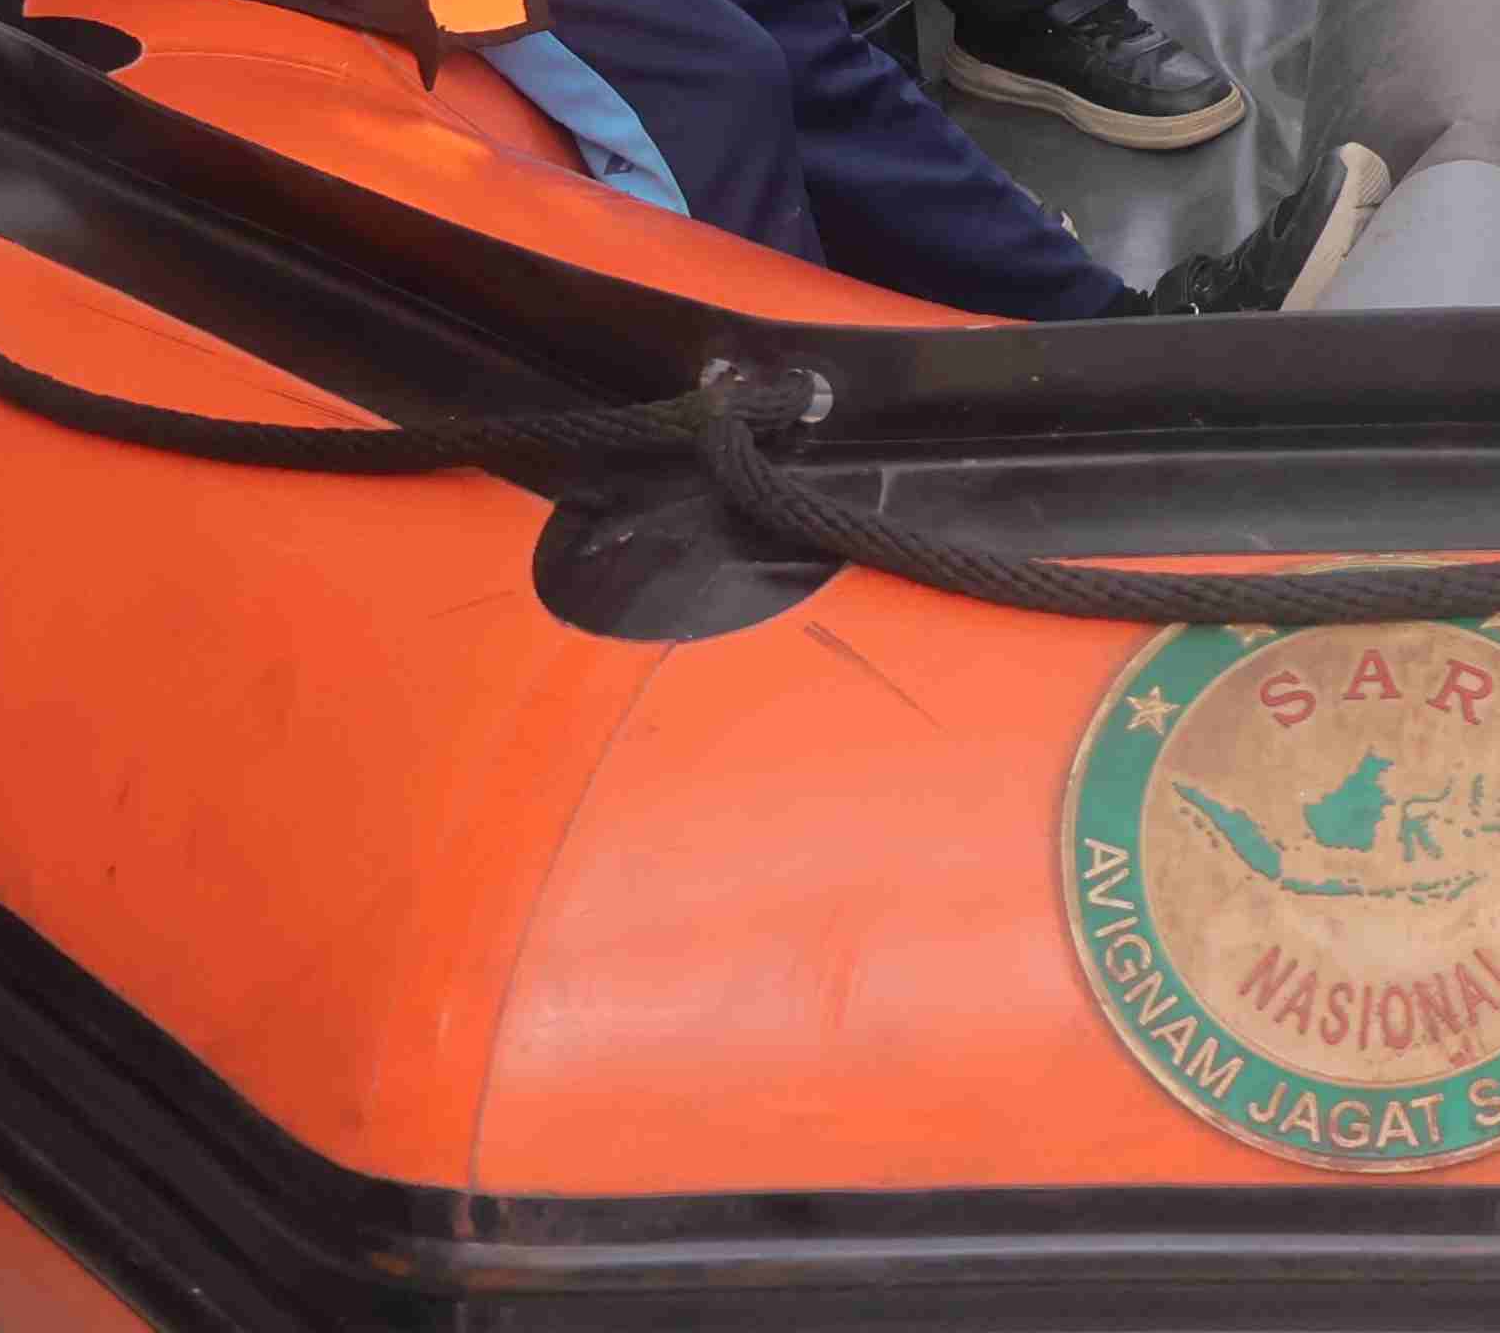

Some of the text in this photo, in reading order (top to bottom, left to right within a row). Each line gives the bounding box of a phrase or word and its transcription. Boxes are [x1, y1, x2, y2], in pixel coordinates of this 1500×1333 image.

[1258, 648, 1494, 726] SAR
[1082, 835, 1244, 1100] AVIGNAM
[1248, 1081, 1446, 1150] JAGAT
